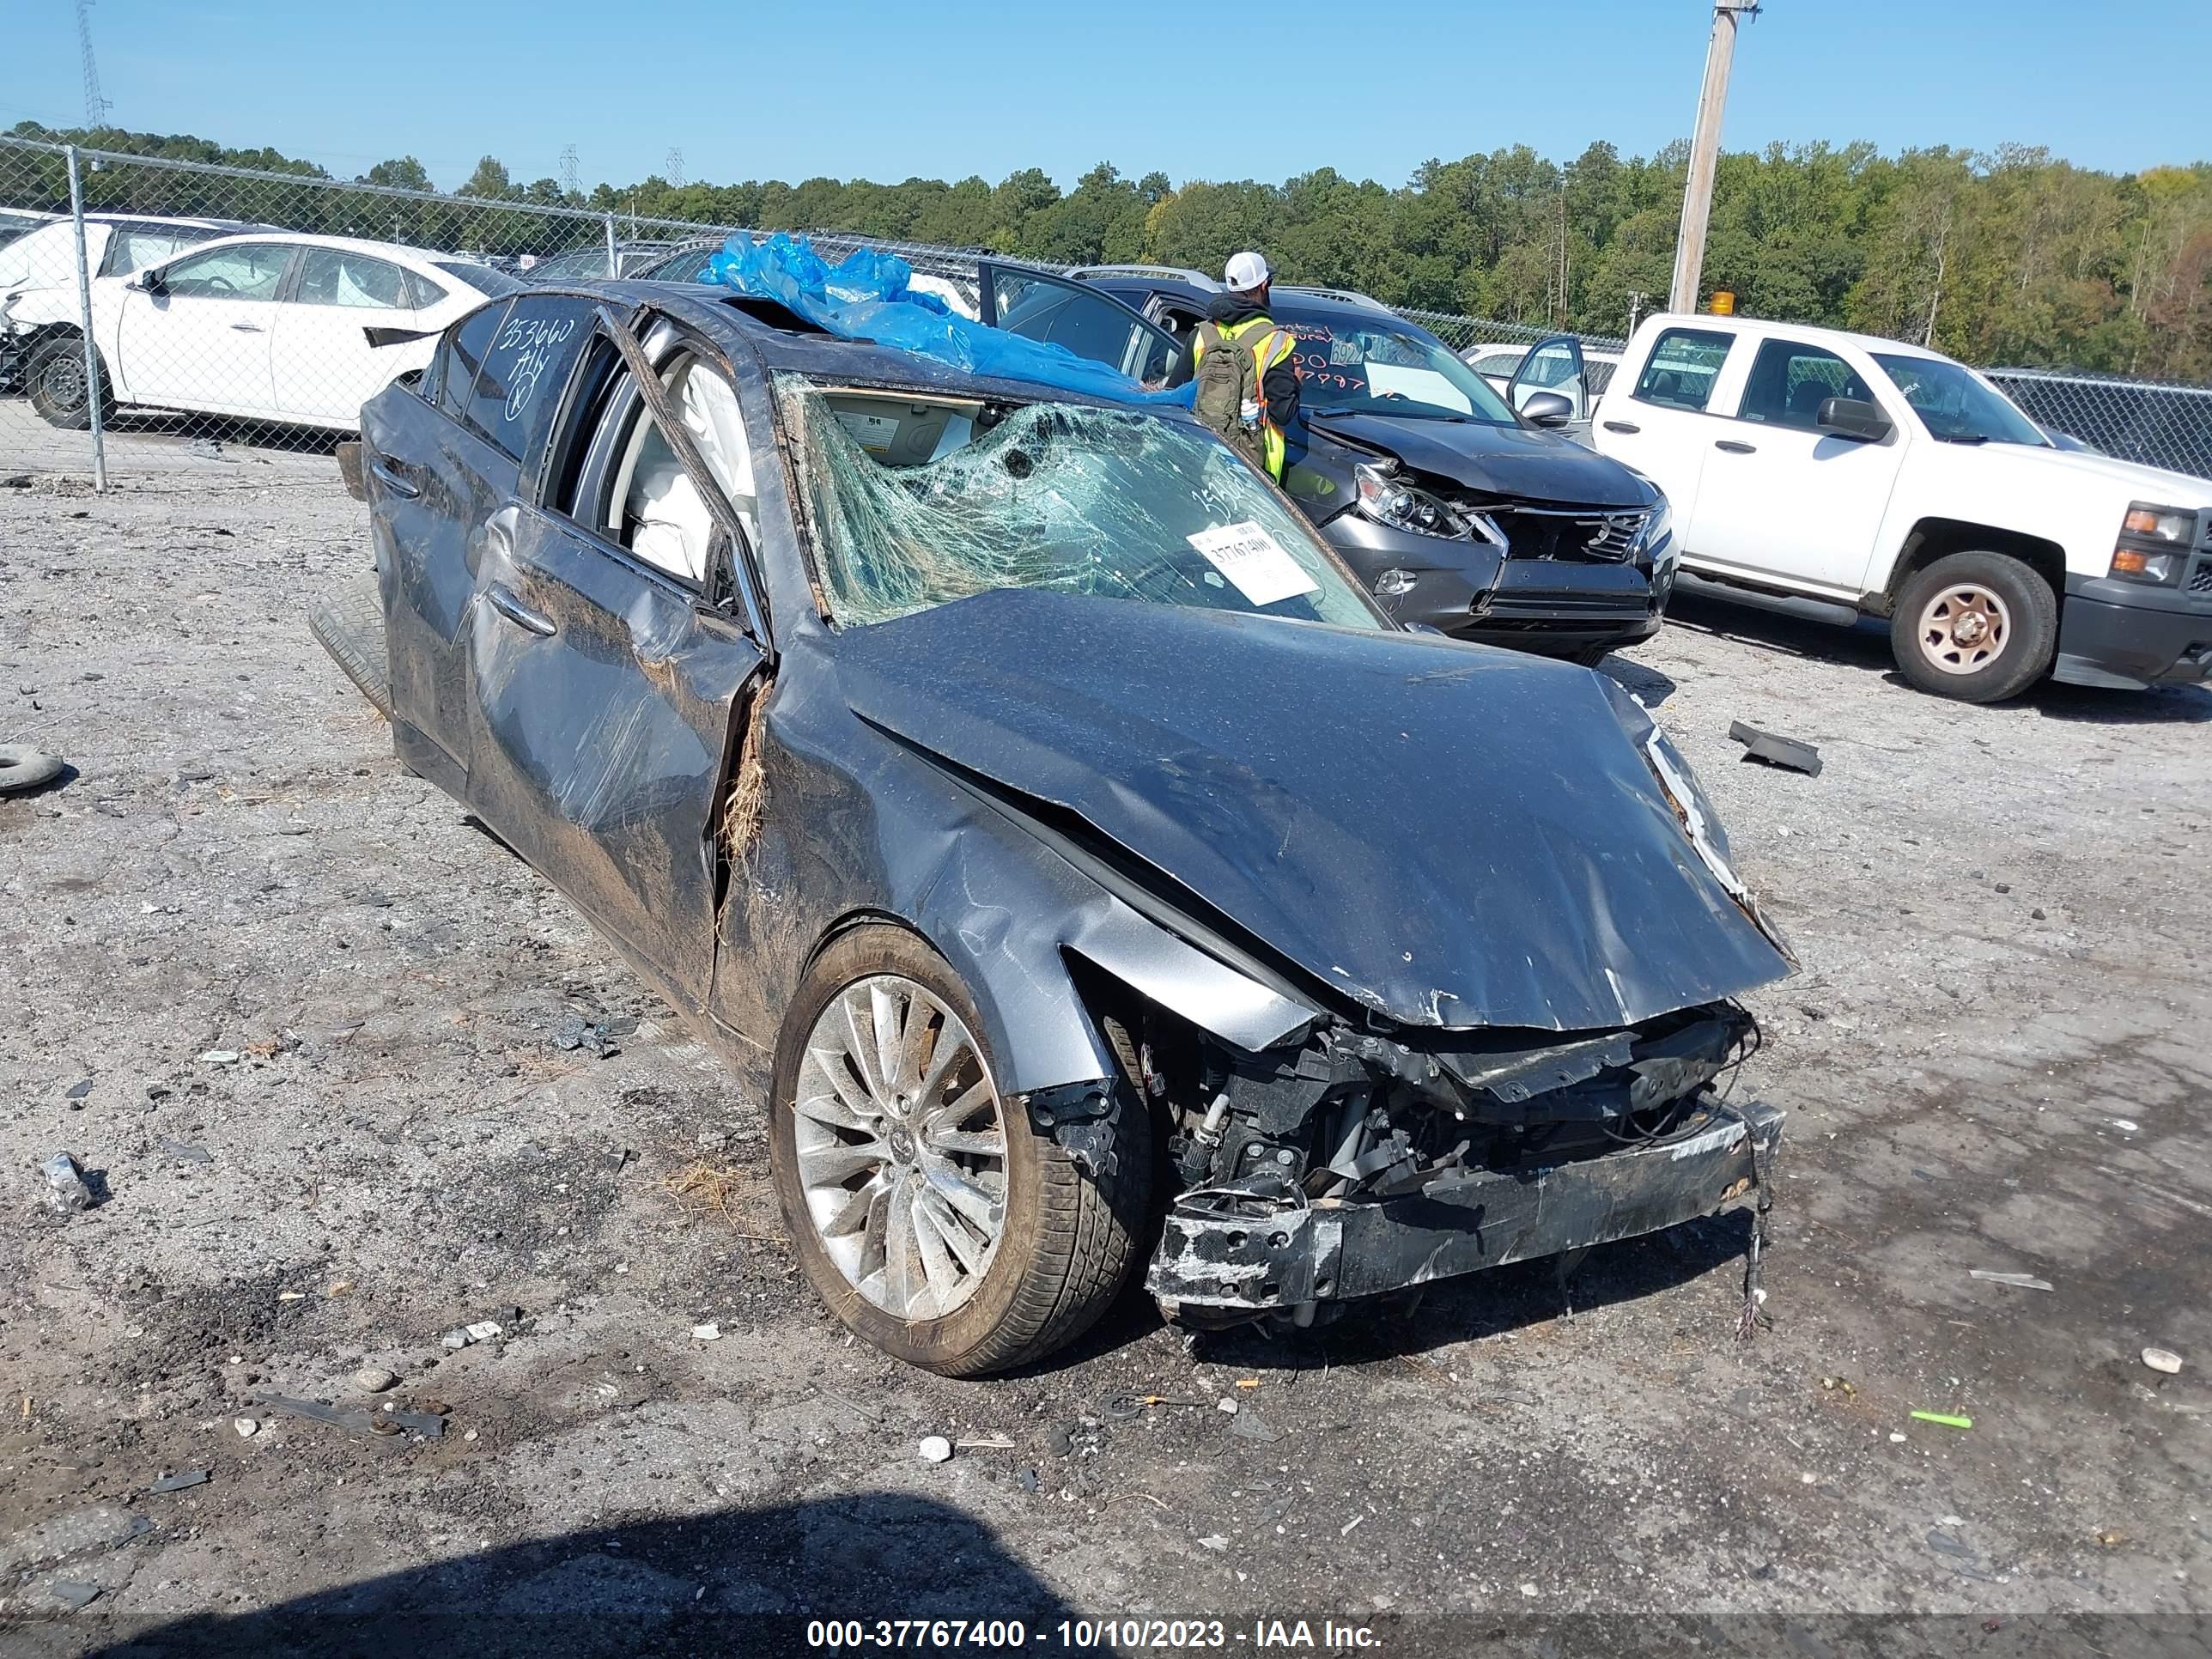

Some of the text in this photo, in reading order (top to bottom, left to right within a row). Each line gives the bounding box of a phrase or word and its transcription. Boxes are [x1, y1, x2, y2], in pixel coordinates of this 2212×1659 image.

[499, 318, 574, 350] 353660
[1331, 343, 1363, 364] 6922
[1211, 538, 1271, 563] 37767400
